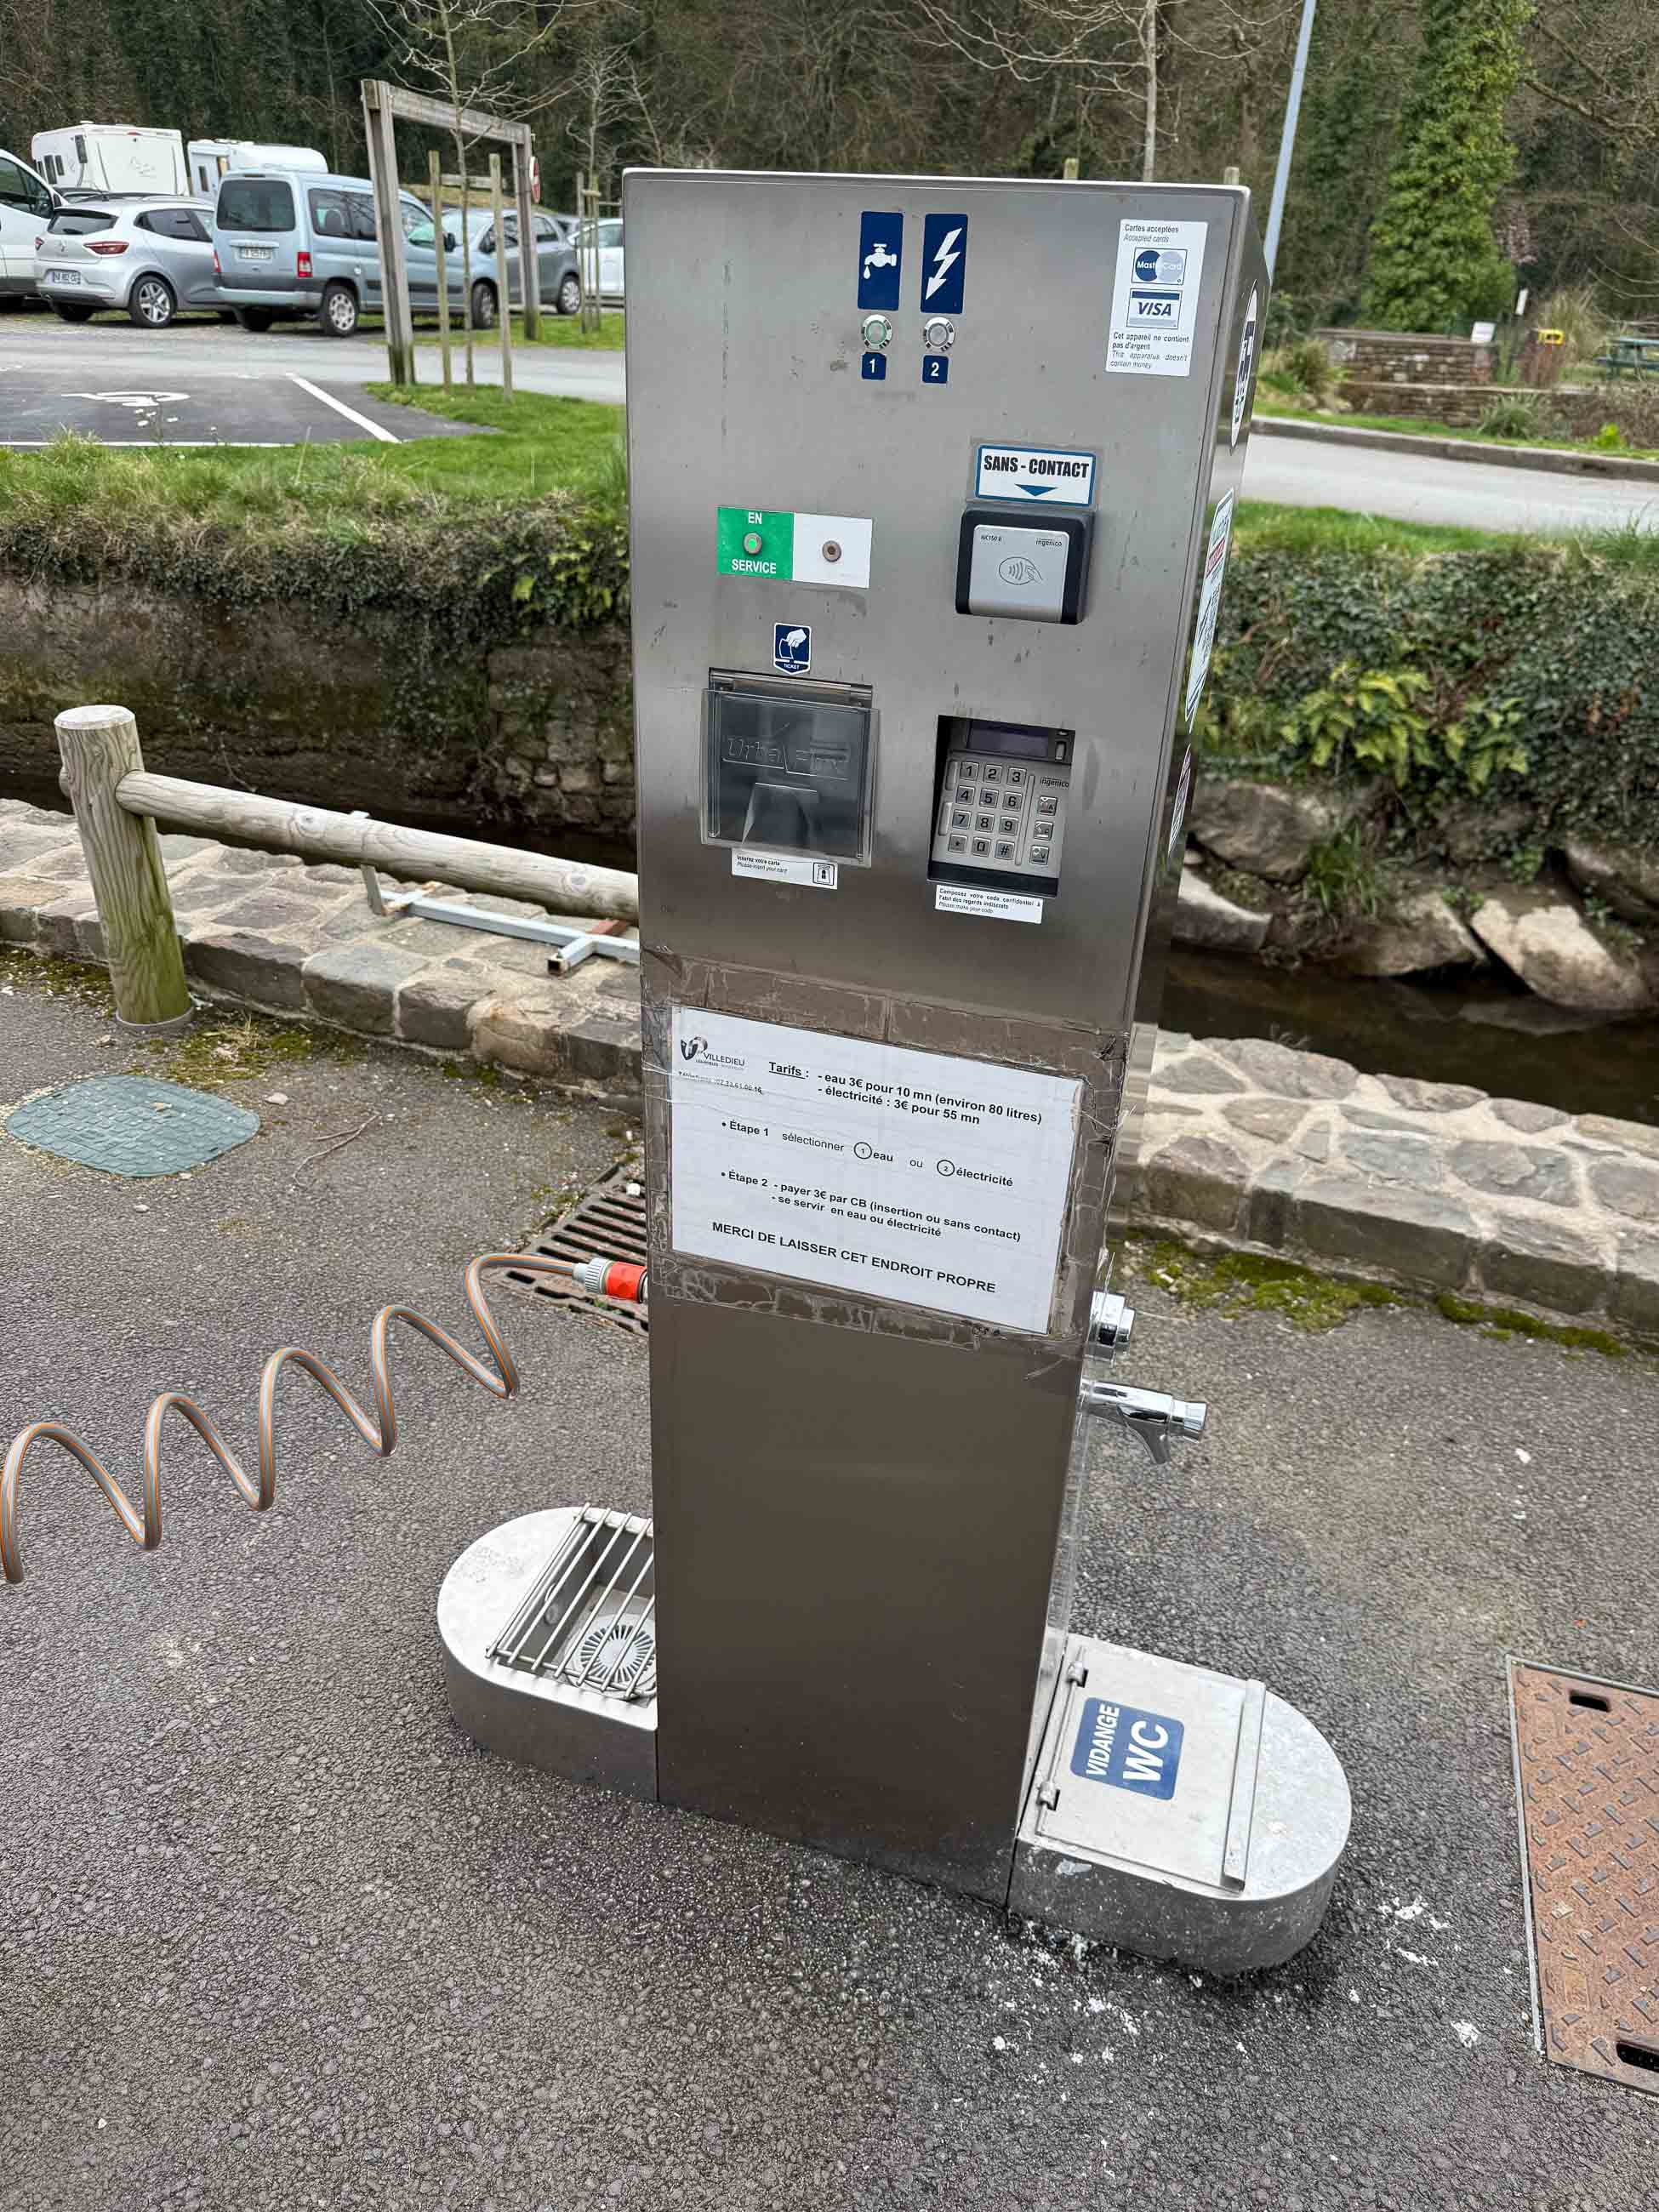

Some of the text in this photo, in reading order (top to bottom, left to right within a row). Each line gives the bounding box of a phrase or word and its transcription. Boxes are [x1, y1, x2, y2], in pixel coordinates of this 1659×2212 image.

[1138, 302, 1172, 316] VISA
[1126, 333, 1151, 342] appareil
[1125, 342, 1150, 351] d'argent
[869, 358, 875, 373] 1
[931, 362, 939, 377] 2
[983, 454, 1018, 473] SANS
[1029, 458, 1090, 478] CONTACT
[748, 512, 762, 525] EN
[732, 558, 777, 574] SERVICE
[966, 766, 1021, 782] 1 2 3
[961, 790, 1017, 807] 4 5 6
[957, 814, 1013, 831] 7 8 9
[704, 1052, 745, 1067] VILLEDIEU
[768, 1061, 803, 1078] Tarifs
[824, 1075, 846, 1085] eau
[849, 1077, 864, 1088] 3€
[866, 1081, 893, 1094] pour
[897, 1086, 910, 1097] 10
[913, 1091, 932, 1102] mn
[935, 1093, 985, 1112] (environ
[989, 1104, 1003, 1115] 80
[1006, 1107, 1042, 1125] litres)
[825, 1086, 883, 1105] électricité
[893, 1099, 909, 1110] 3€
[911, 1104, 940, 1116] pour
[943, 1109, 957, 1120] 55
[961, 1115, 980, 1125] mn
[729, 1120, 769, 1137] Étape 1
[782, 1133, 845, 1152] sélectionner
[873, 1152, 893, 1161] eau
[909, 1159, 923, 1168] ou
[956, 1167, 1013, 1187] électricité
[728, 1169, 760, 1185] Étape
[761, 1178, 768, 1187] 2
[780, 1183, 812, 1196] payer
[813, 1189, 827, 1200] 3€
[830, 1193, 848, 1203] par
[850, 1197, 867, 1207] CB
[869, 1201, 923, 1220] (insertion
[926, 1215, 940, 1223] ou
[944, 1218, 971, 1230] sans
[973, 1224, 1022, 1243] contact)
[778, 1195, 791, 1204] se
[794, 1199, 825, 1211] servir
[830, 1207, 844, 1216] en
[847, 1211, 867, 1221] eau
[869, 1215, 884, 1224] ou
[887, 1217, 942, 1237] électricité
[712, 1222, 996, 1293] MERCI DE LAISSER CET ENDROIT PROPRE
[1086, 1702, 1120, 1776] VIDANGE
[1122, 1720, 1169, 1782] WC
